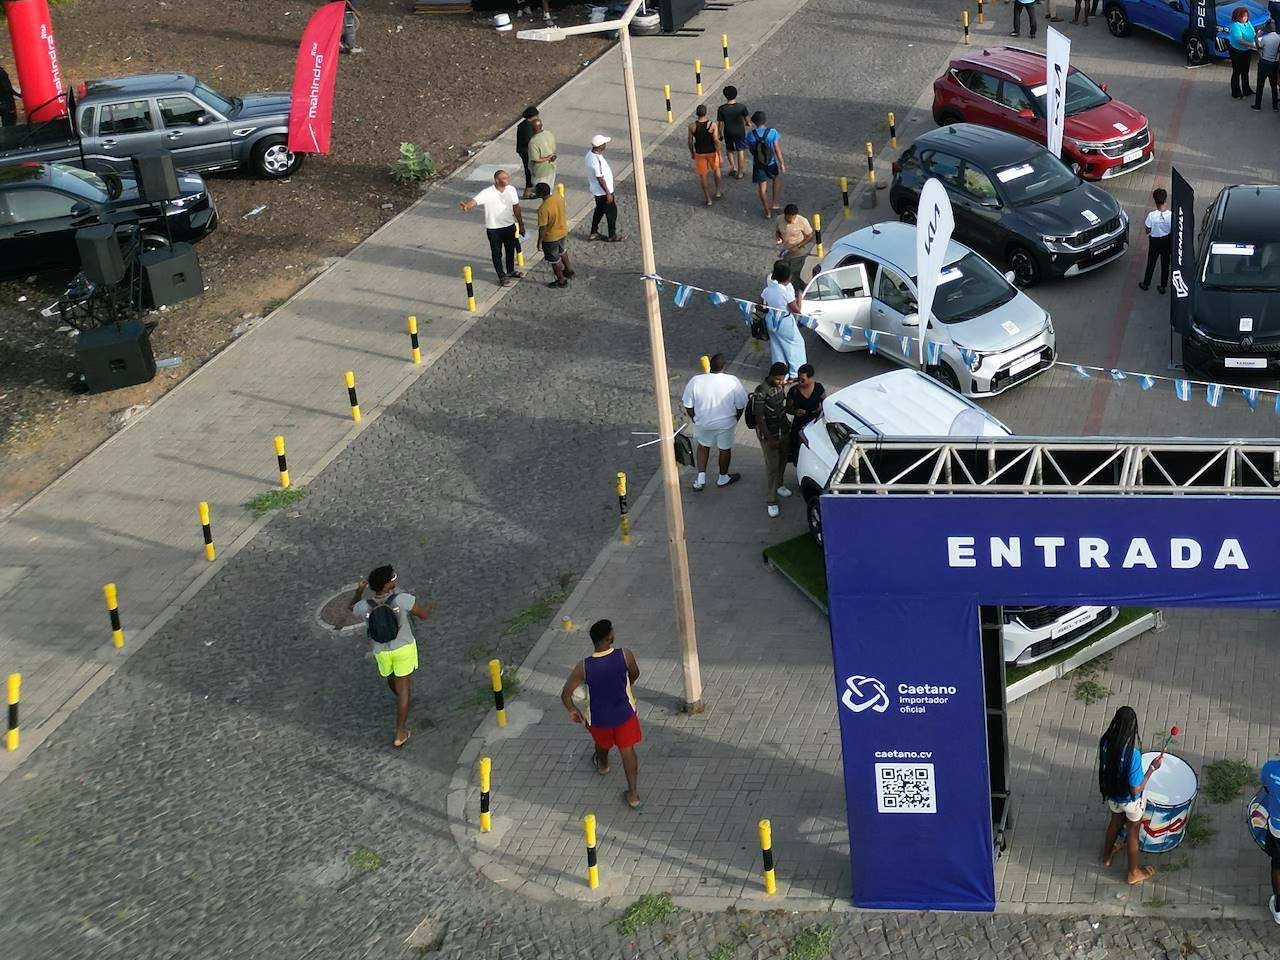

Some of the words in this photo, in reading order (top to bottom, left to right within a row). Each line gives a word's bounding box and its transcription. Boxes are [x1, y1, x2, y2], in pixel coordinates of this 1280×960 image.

[309, 54, 323, 118] mahindra
[947, 535, 1250, 570] ENTRADA
[898, 683, 957, 695] Caetano
[899, 696, 949, 705] importador
[900, 705, 926, 713] oficial
[874, 750, 932, 758] caetano.cv
